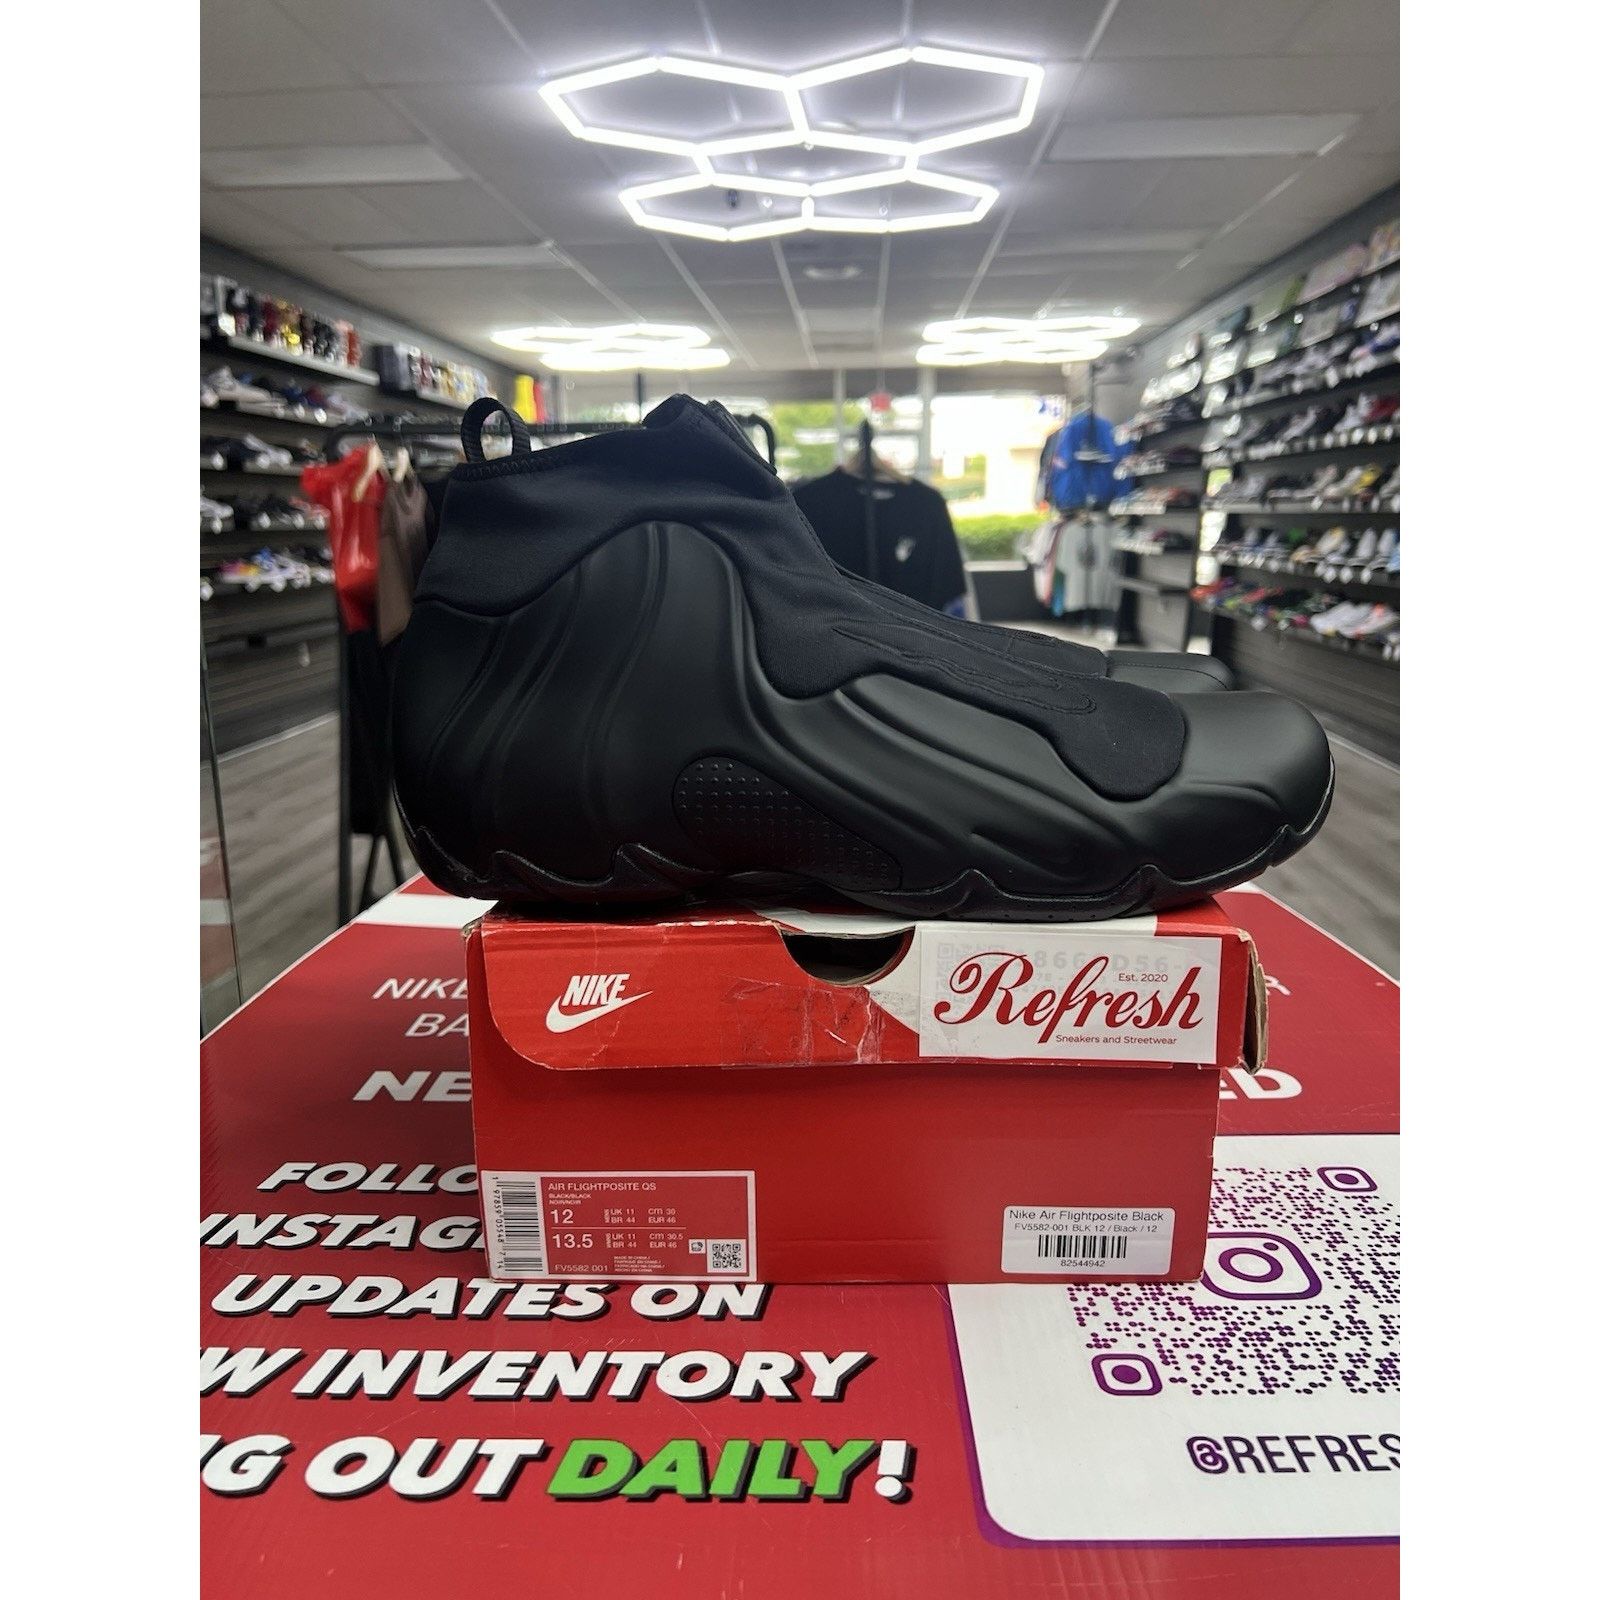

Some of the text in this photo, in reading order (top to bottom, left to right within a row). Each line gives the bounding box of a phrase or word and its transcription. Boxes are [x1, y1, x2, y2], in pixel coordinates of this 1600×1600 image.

[1118, 973, 1169, 983] Est. 2020
[561, 973, 631, 1007] NIKE
[934, 951, 1204, 1044] Refresh
[1055, 1034, 1178, 1045] Sneakers and Streetwear
[548, 1182, 657, 1192] AIR FLIGHTPOSITE QS
[550, 1208, 574, 1224] 12
[610, 1208, 623, 1216] UK
[626, 1208, 636, 1216] 11
[1009, 1210, 1164, 1222] Nike Air Flightposite Black
[611, 1216, 623, 1224] BR
[625, 1216, 636, 1224] 44
[648, 1216, 665, 1224] EUR
[666, 1216, 677, 1224] 46
[1014, 1223, 1068, 1231] FV5582-001
[1072, 1224, 1091, 1232] BLK
[1095, 1224, 1105, 1232] 12
[1147, 1225, 1158, 1233] 12
[552, 1233, 594, 1249] 13.5
[612, 1232, 624, 1240] UK
[627, 1232, 637, 1240] 11
[667, 1232, 684, 1240] 30.5
[612, 1241, 678, 1249] BR 44 EUR 46
[554, 1264, 590, 1272] FV5582
[1060, 1259, 1106, 1268] 82544942
[211, 1274, 769, 1319] UPDATES ON
[291, 1347, 870, 1400] INVENTORY
[304, 1434, 546, 1497] OUT
[546, 1438, 910, 1499] DAILY!
